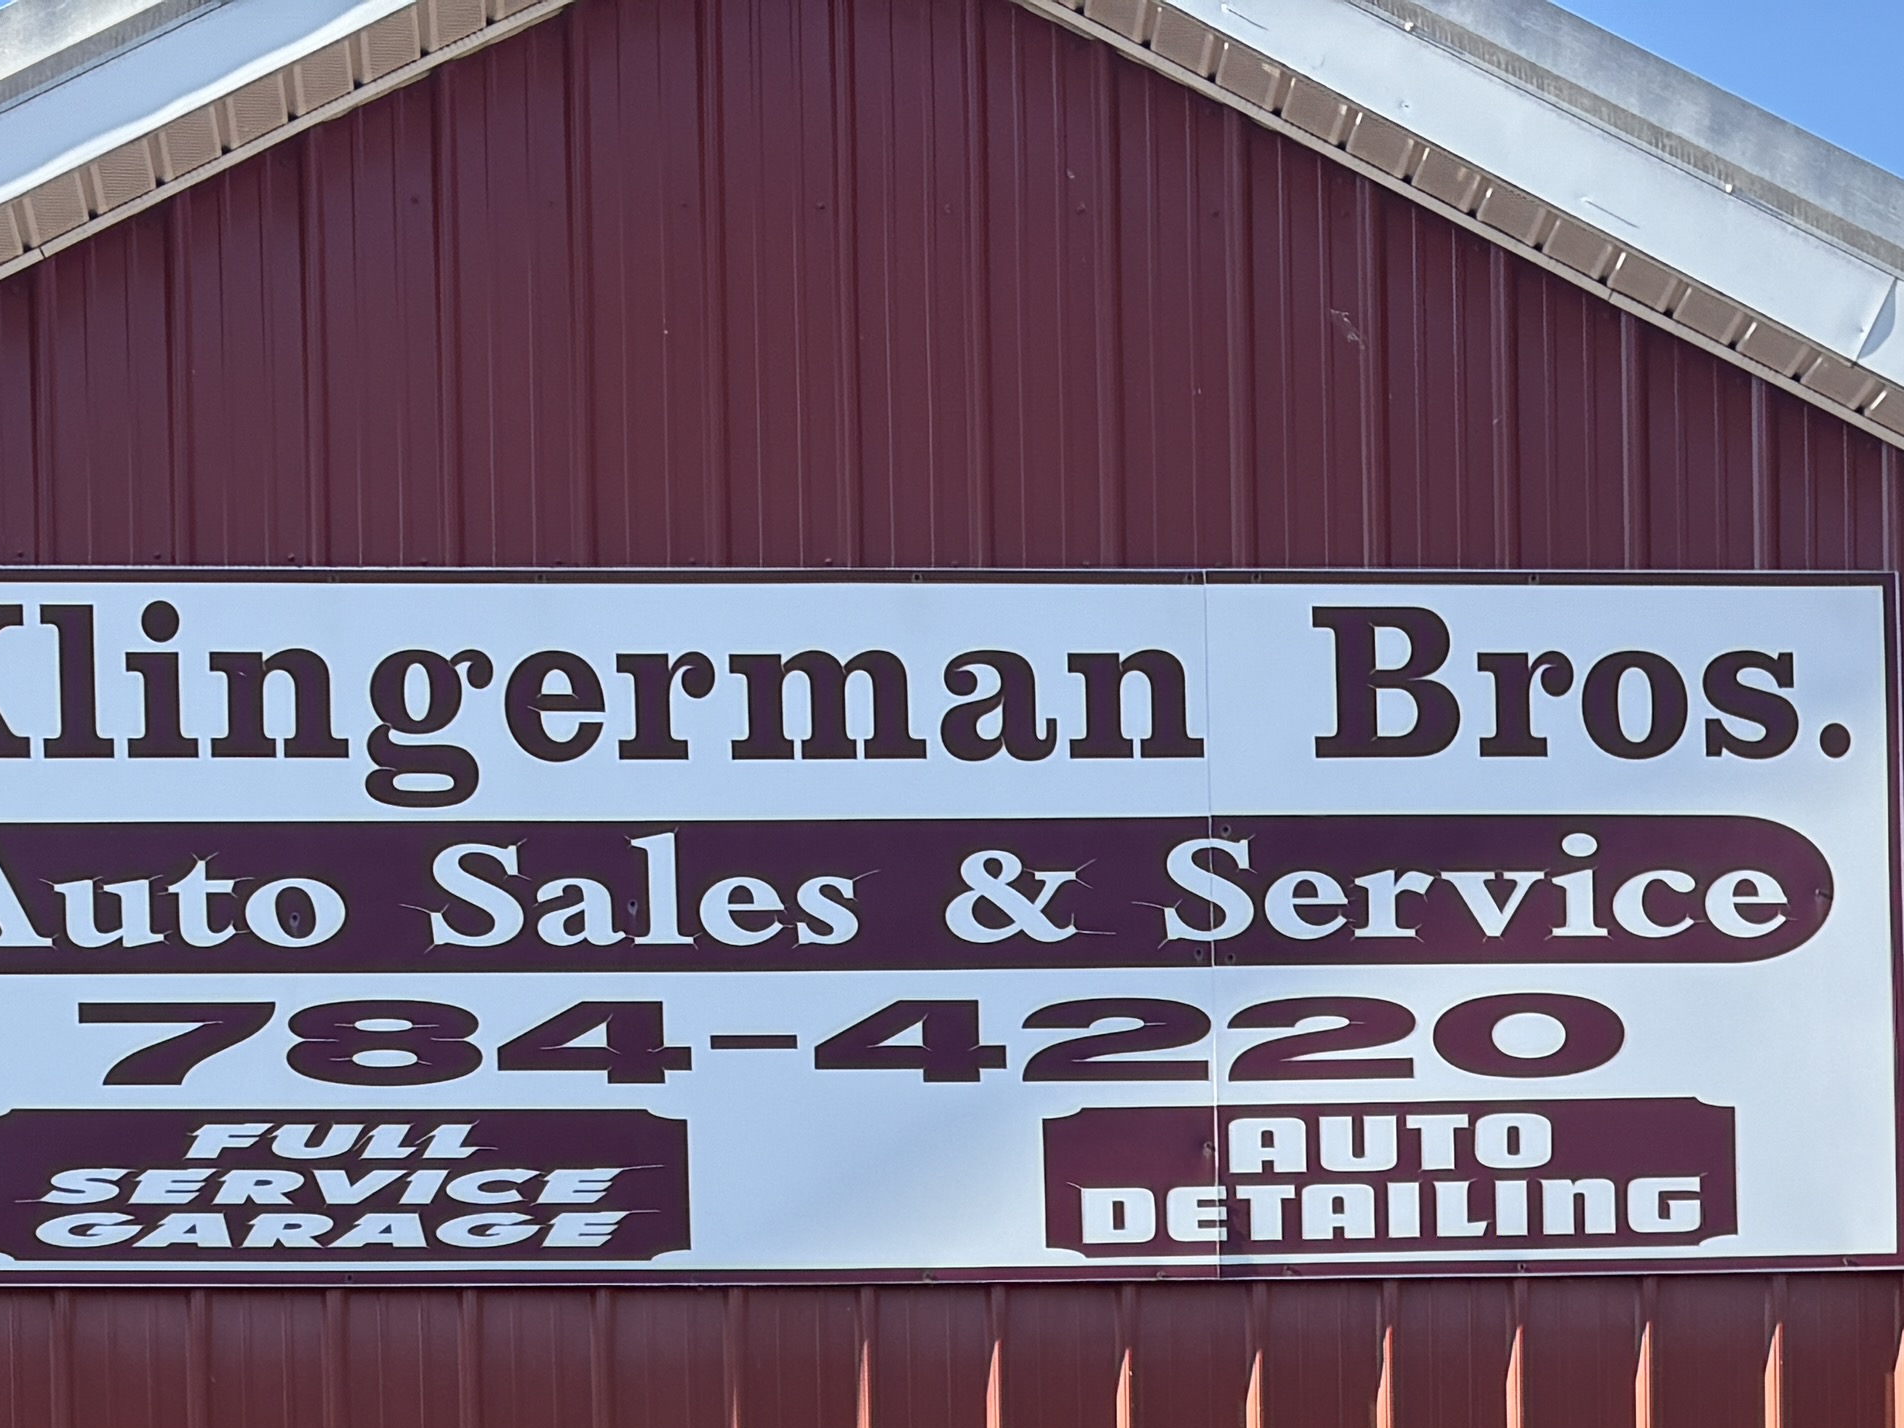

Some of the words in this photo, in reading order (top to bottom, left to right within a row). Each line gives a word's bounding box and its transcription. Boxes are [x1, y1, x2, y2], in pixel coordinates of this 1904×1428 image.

[1312, 604, 1850, 760] Bros.
[422, 833, 858, 946] Sales
[946, 850, 1078, 943] &
[1164, 833, 1787, 941] Service
[78, 993, 1624, 1086] 784-4220
[185, 1123, 488, 1159] FULL
[1229, 1113, 1551, 1173] AUTO
[35, 1168, 630, 1205] SERVICE
[1075, 1177, 1700, 1243] DETAILING
[36, 1211, 631, 1247] GARAGE
